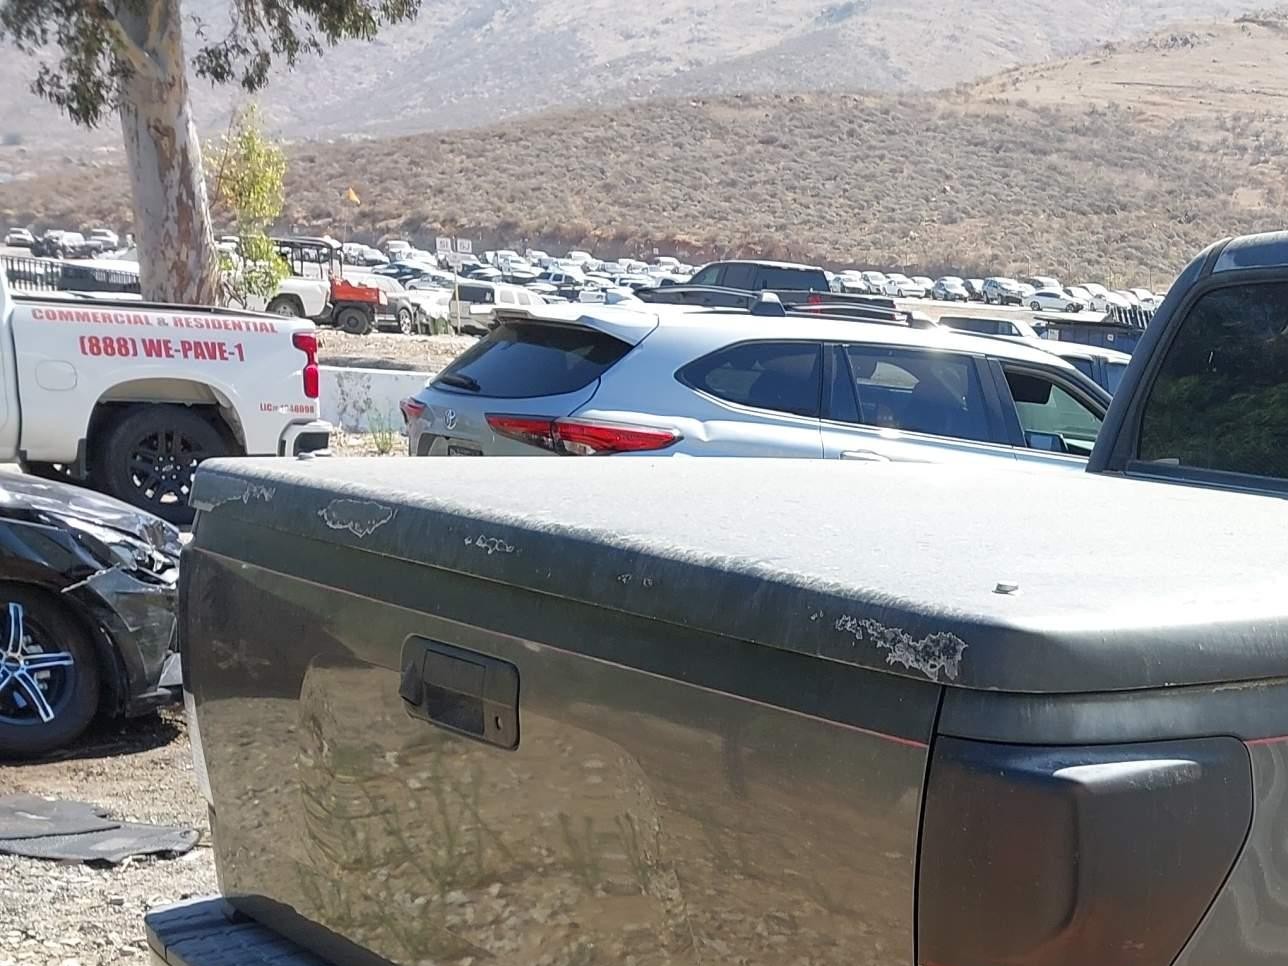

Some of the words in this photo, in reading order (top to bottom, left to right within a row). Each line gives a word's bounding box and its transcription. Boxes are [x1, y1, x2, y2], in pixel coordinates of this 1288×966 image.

[32, 308, 153, 327] COMMERCIAL
[156, 316, 169, 327] &
[173, 316, 279, 335] RESIDENTIAL
[79, 334, 138, 358] (888)
[140, 337, 246, 363] WE-PAVE-1
